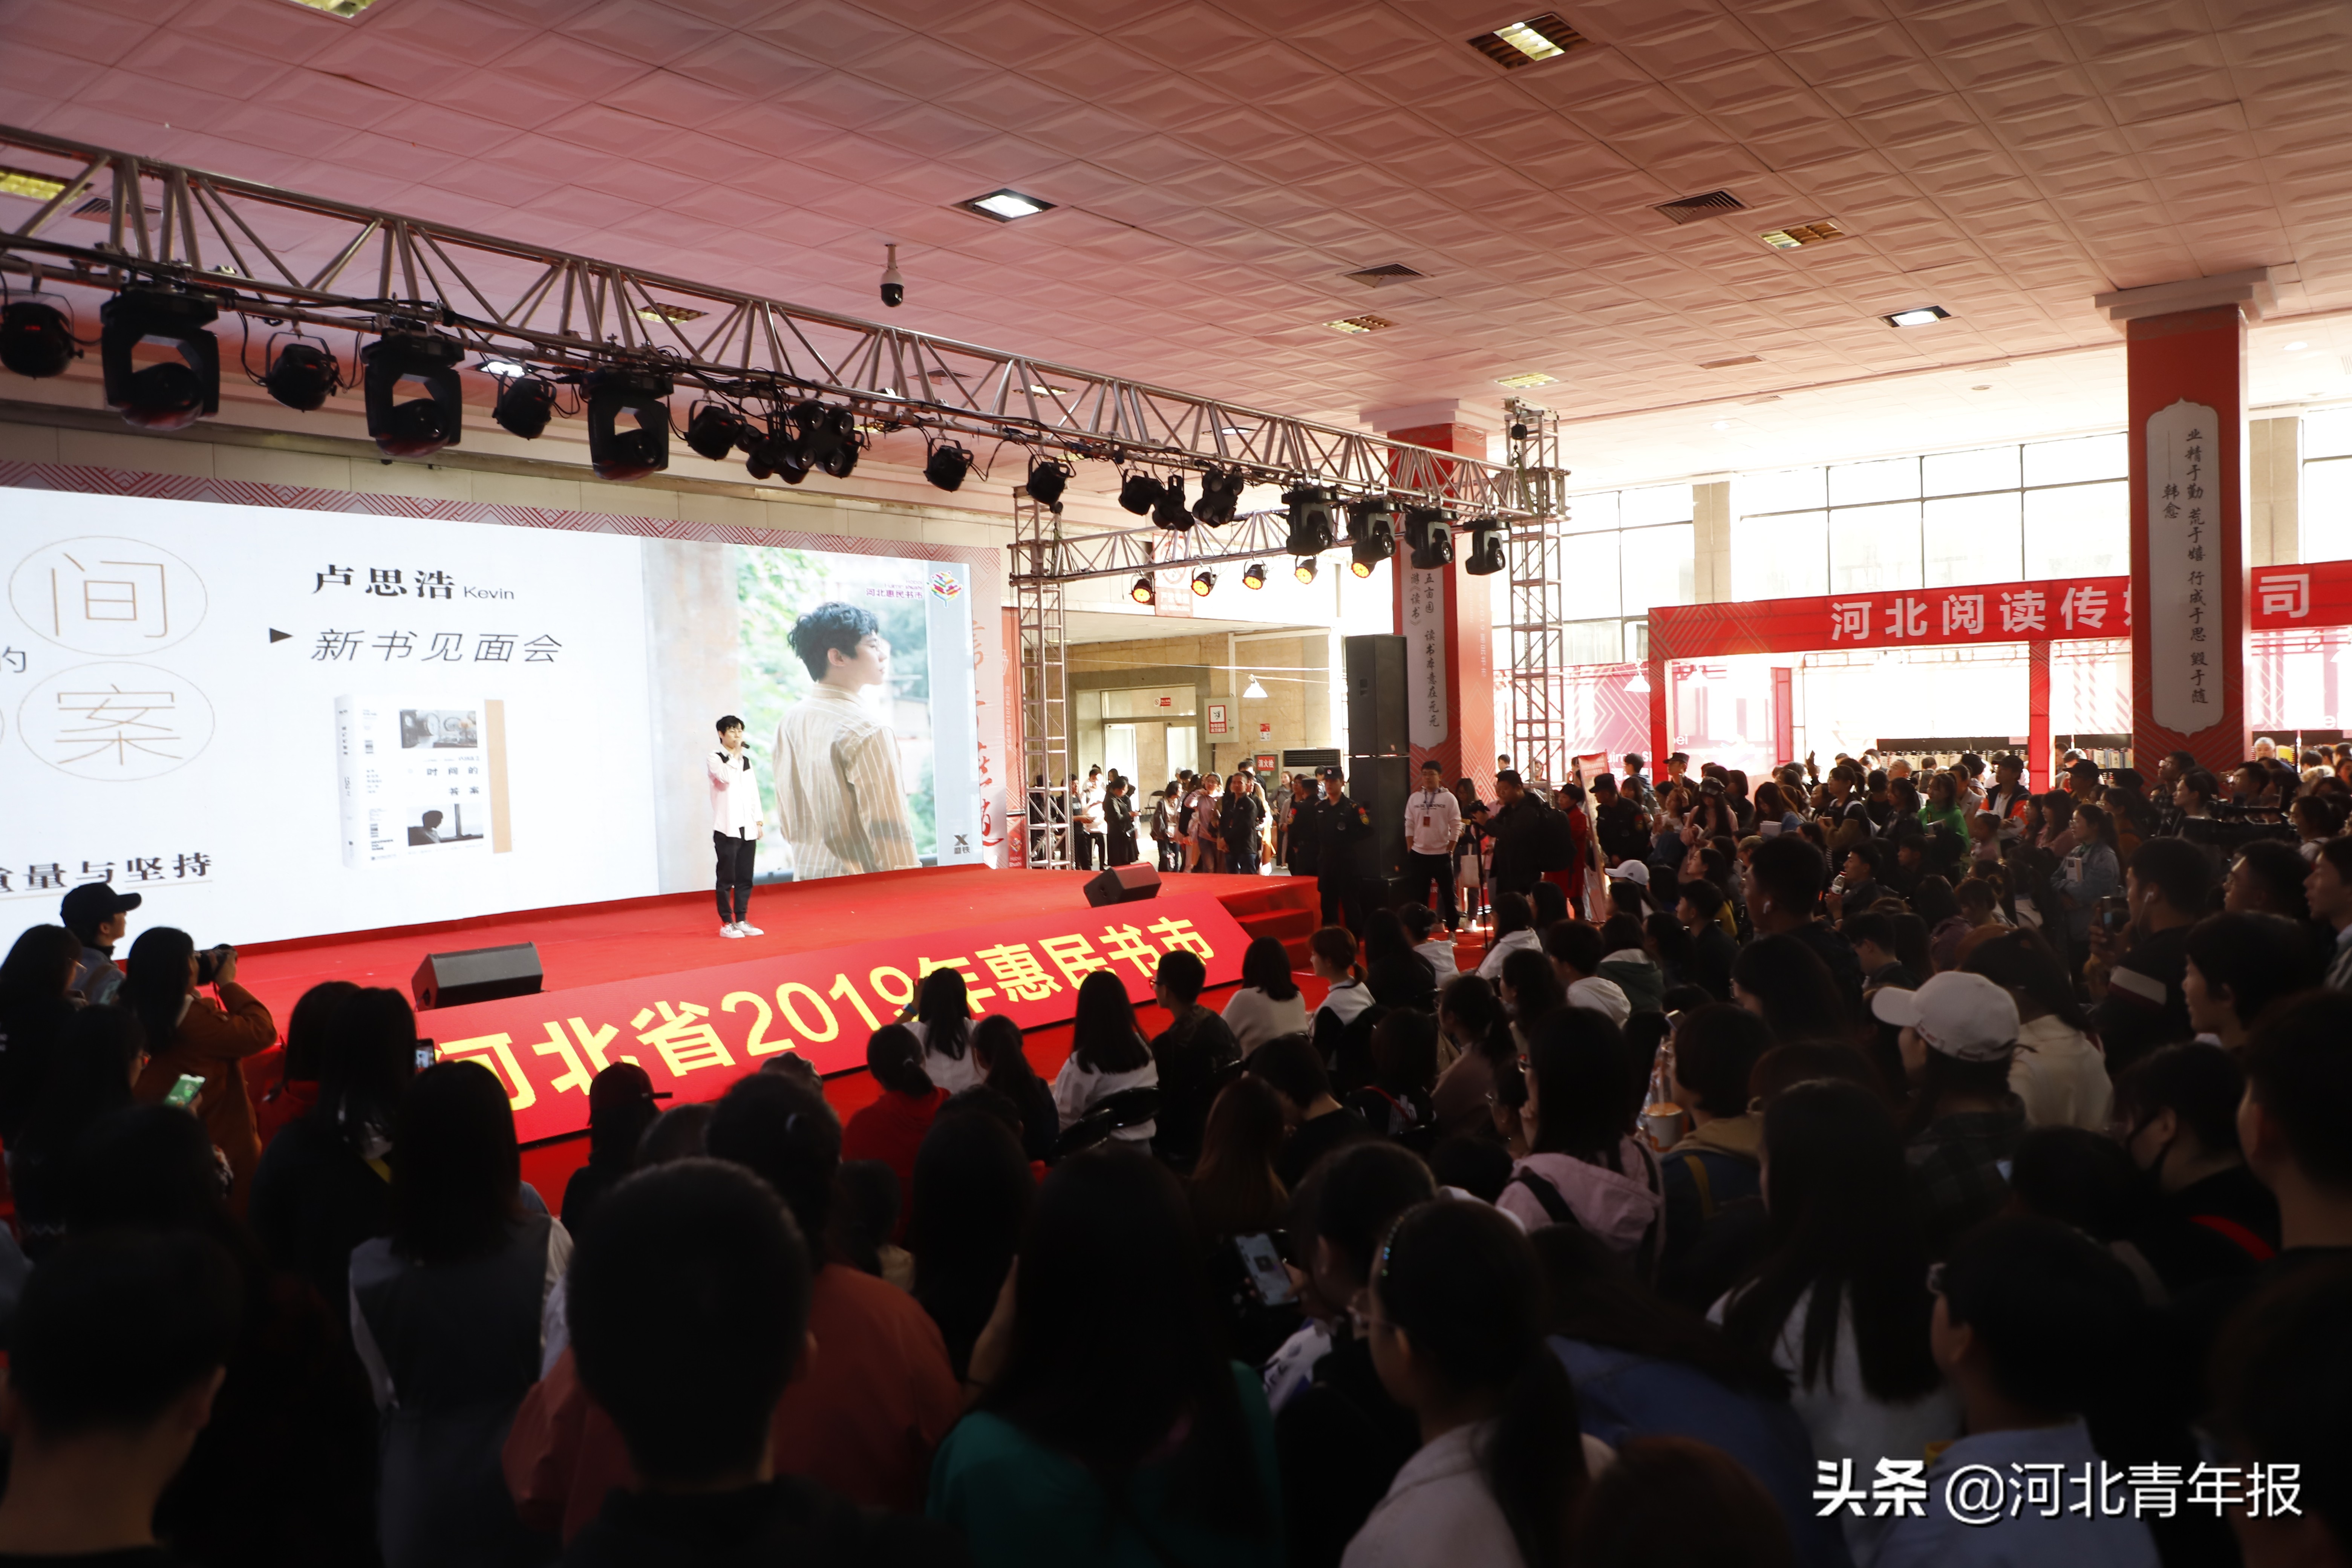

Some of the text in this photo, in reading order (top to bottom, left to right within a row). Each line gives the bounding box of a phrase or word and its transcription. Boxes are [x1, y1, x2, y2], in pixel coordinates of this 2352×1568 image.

[52, 553, 167, 638] 间
[311, 564, 514, 600] 卢思浩 Kevin
[866, 588, 923, 599] 河北惠民书市
[311, 628, 562, 663] 新书见面会
[55, 684, 183, 766] 案
[1258, 759, 1274, 768] 消火栓
